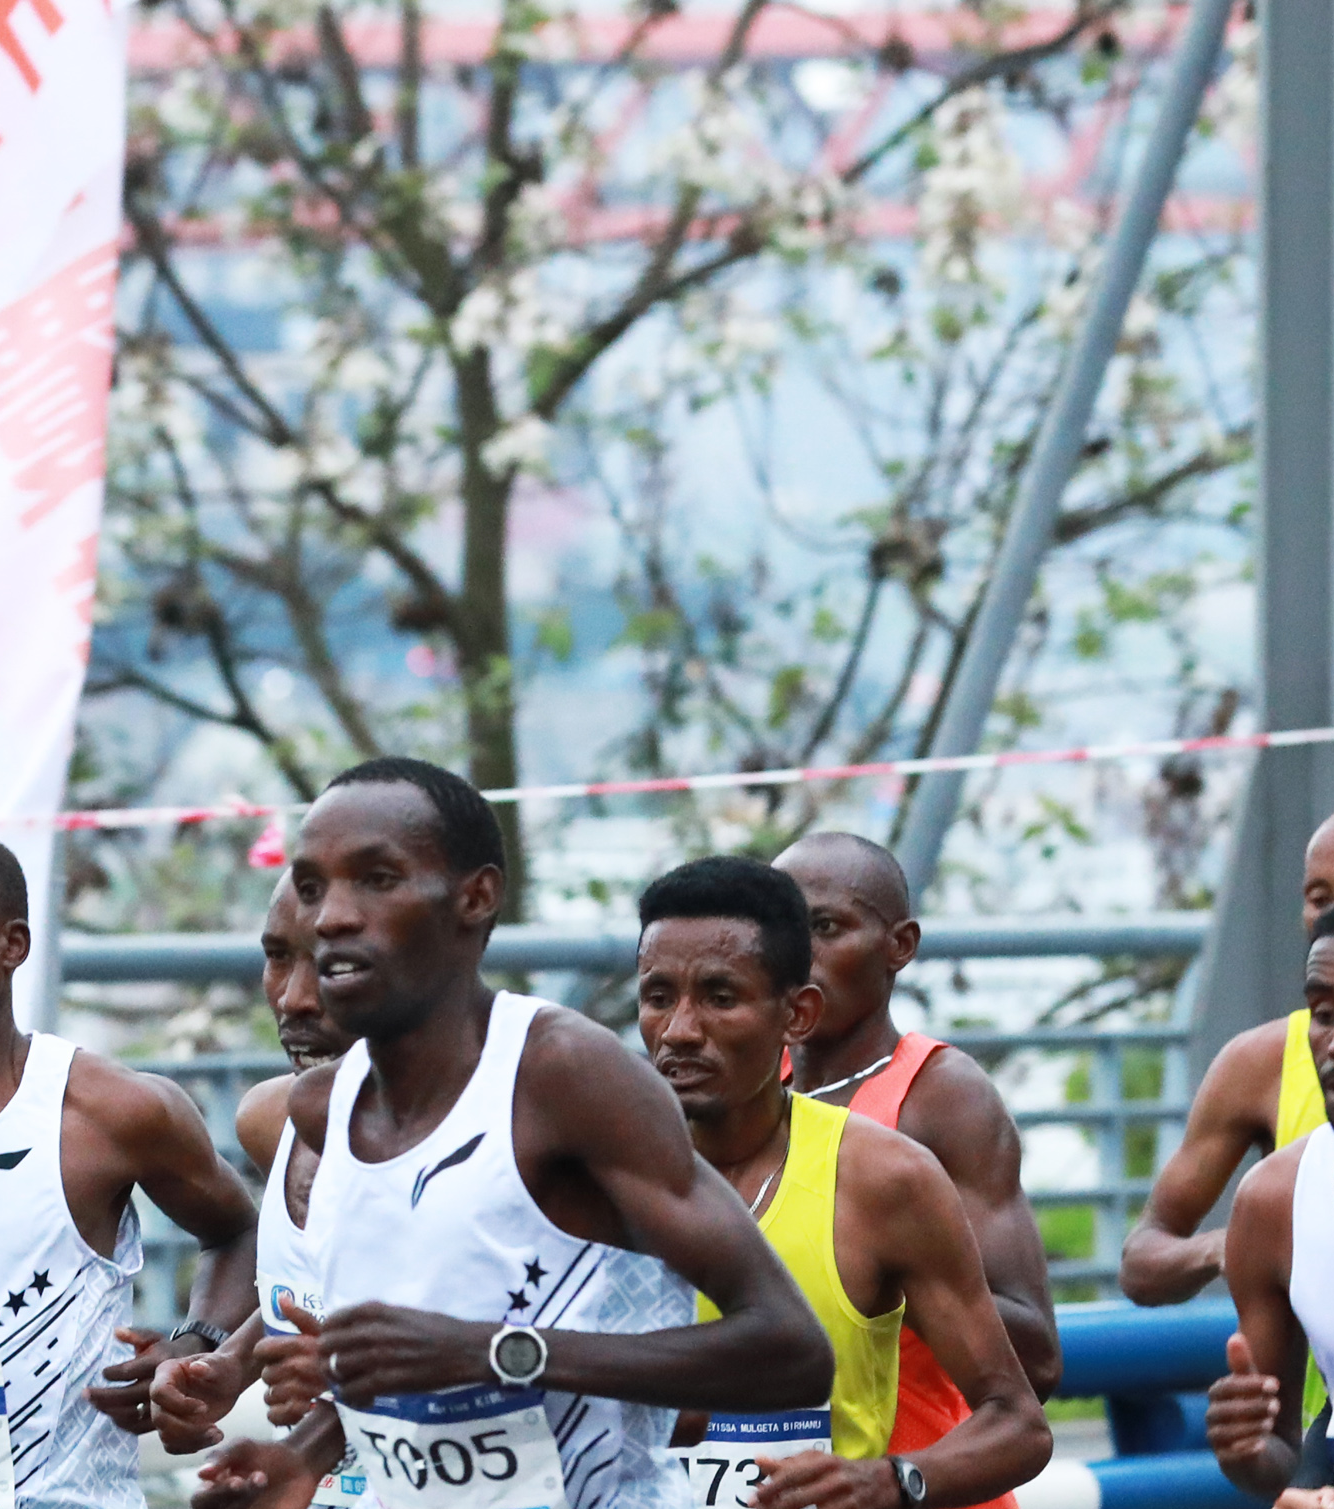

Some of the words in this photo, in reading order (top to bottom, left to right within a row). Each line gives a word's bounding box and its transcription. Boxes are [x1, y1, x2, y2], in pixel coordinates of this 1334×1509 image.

[740, 1422, 779, 1433] MULGETA
[783, 1420, 822, 1431] BIRHANU
[360, 1429, 519, 1490] T005
